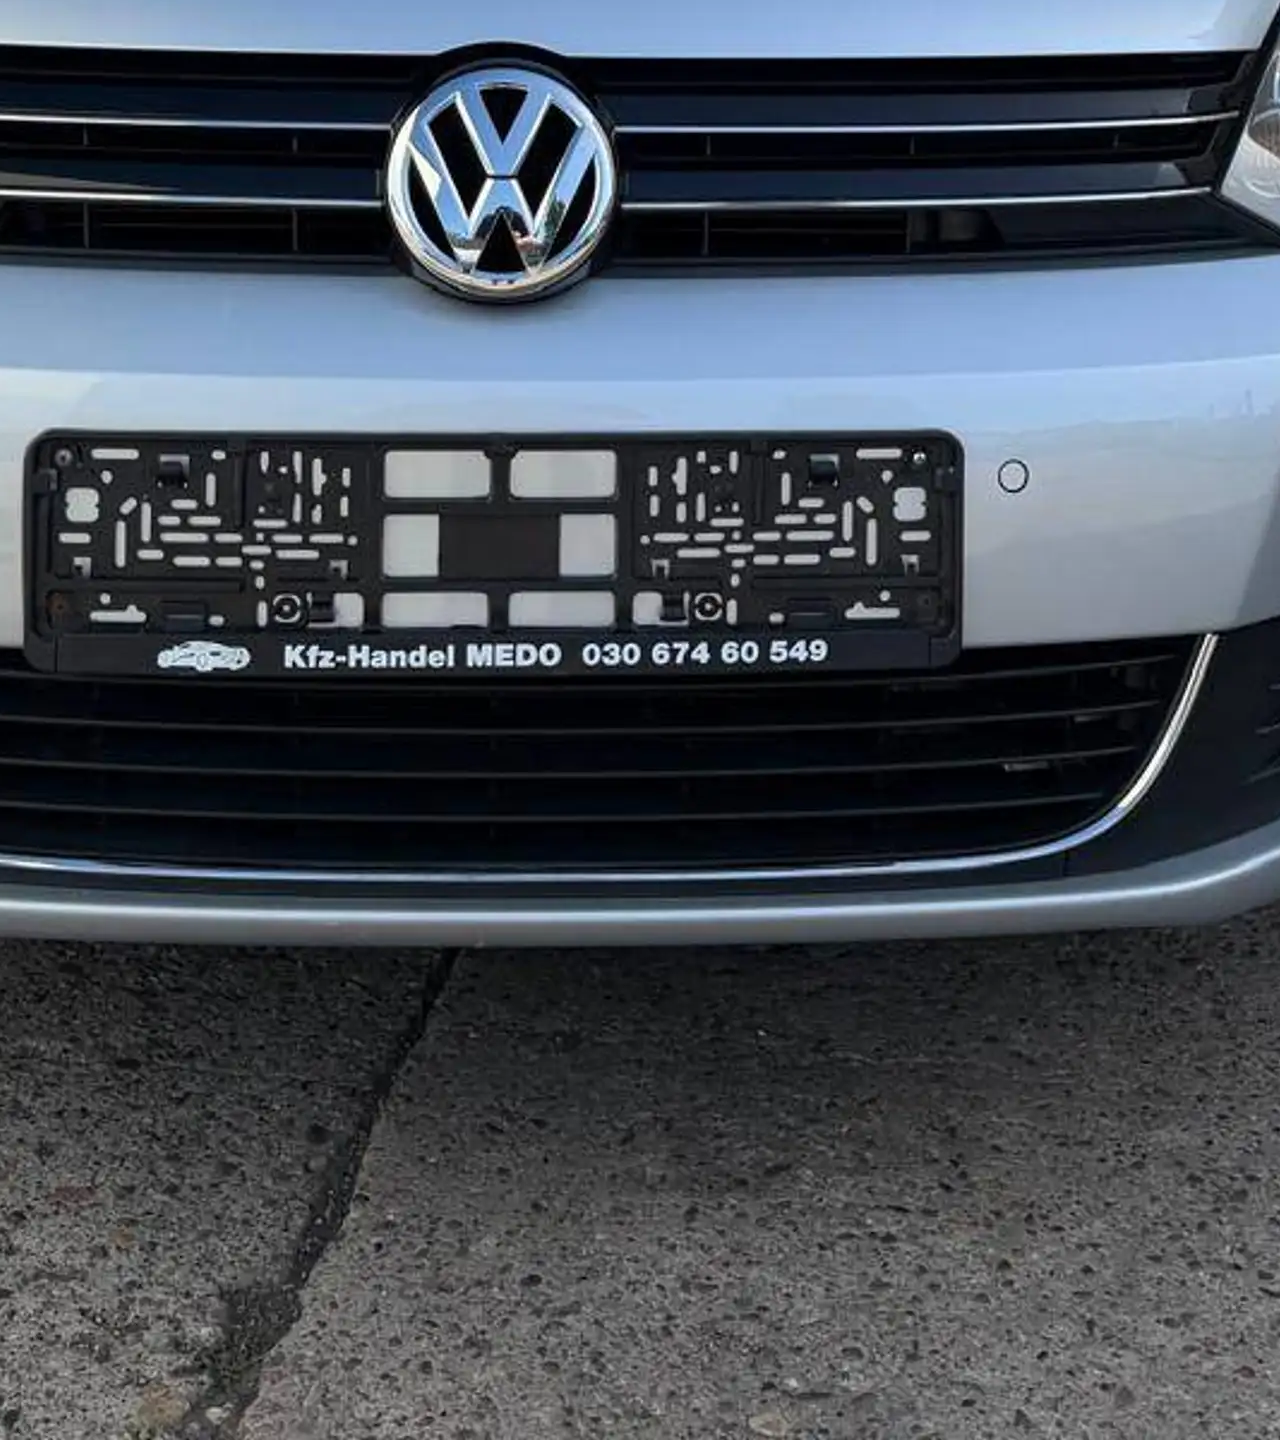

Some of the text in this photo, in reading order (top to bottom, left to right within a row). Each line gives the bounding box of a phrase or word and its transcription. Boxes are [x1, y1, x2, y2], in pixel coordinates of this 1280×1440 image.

[284, 639, 828, 669] Kfz-Handel MEDO 030 674 60 549
